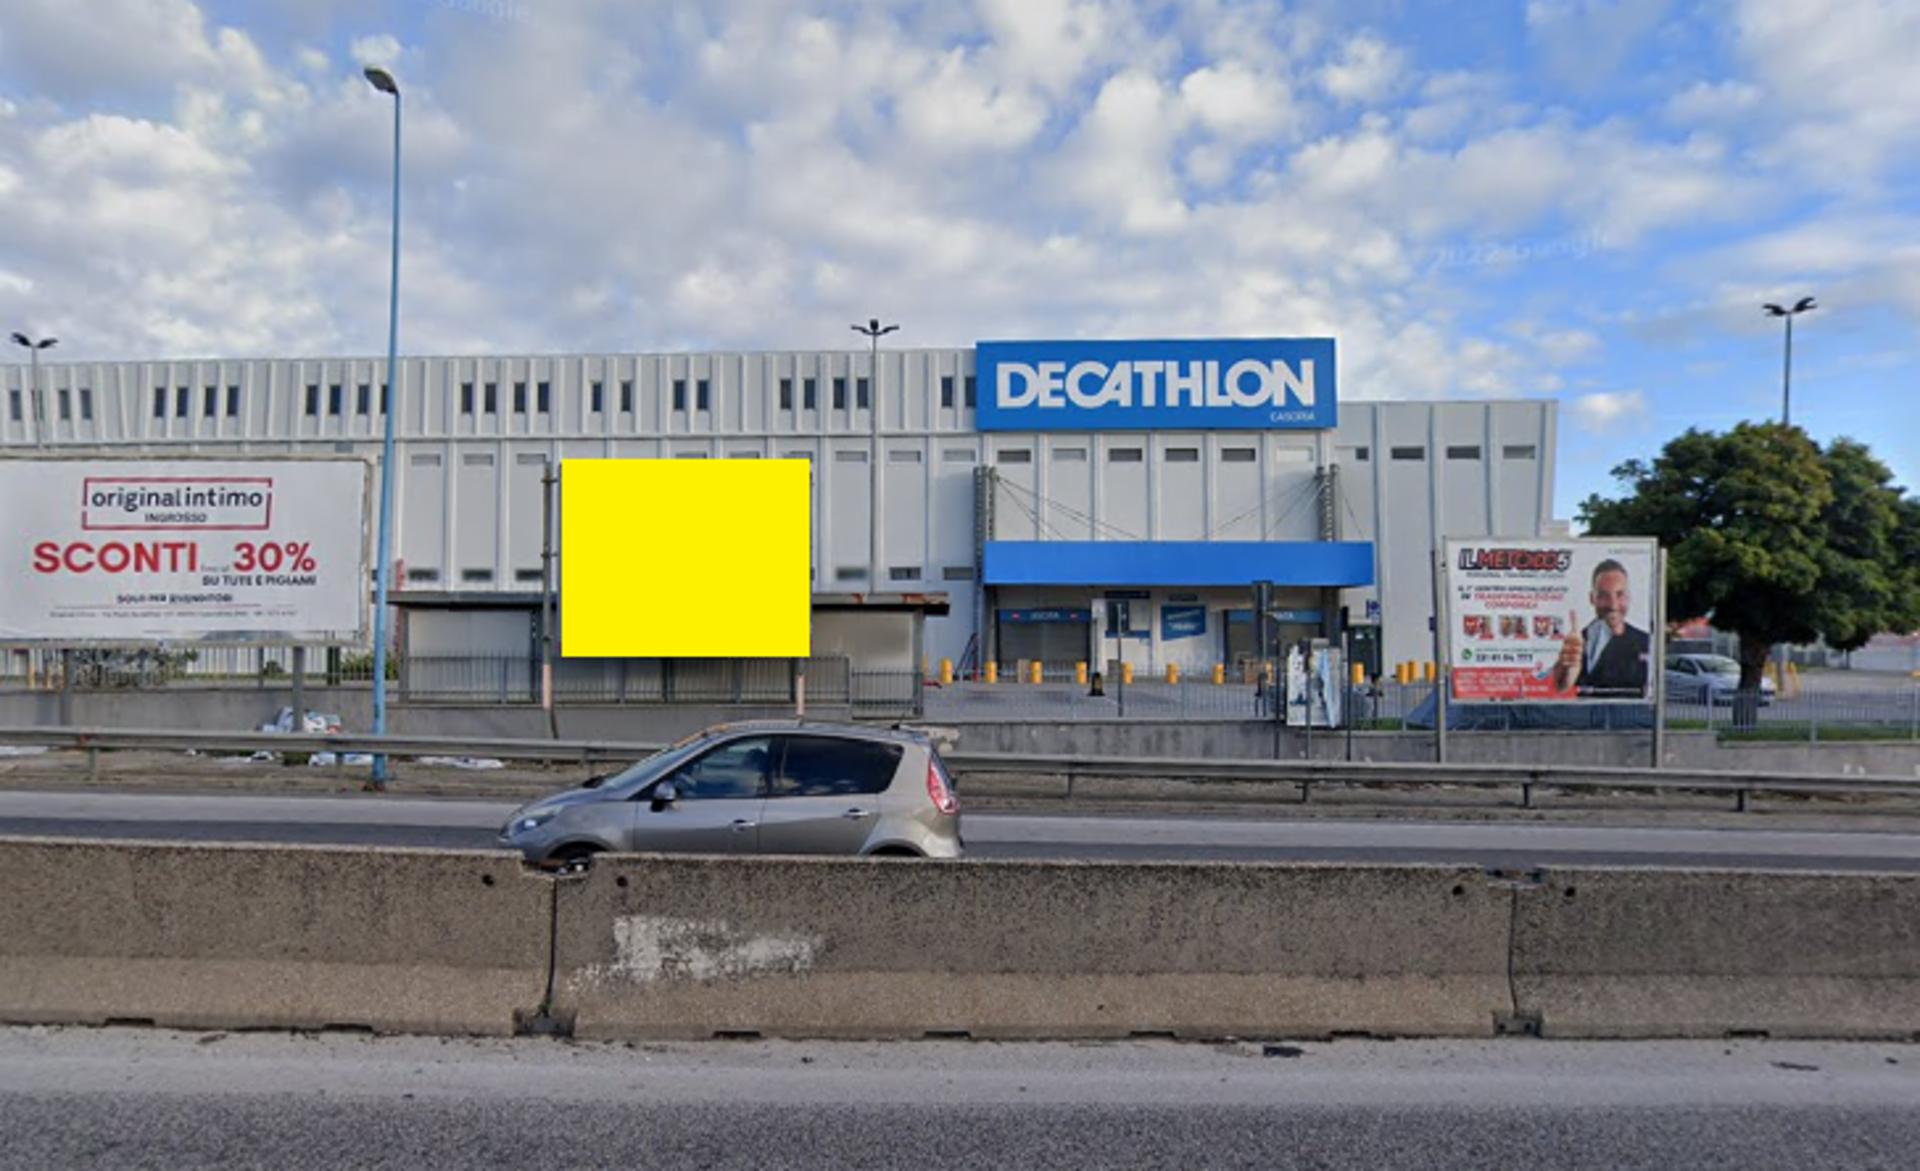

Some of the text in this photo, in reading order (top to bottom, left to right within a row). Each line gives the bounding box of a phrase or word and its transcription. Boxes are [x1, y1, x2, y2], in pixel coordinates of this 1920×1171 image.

[996, 358, 1315, 409] DECATHLON
[144, 513, 208, 524] INGROSSO
[33, 541, 197, 573] SCONTI
[234, 541, 317, 573] 30%
[202, 575, 220, 587] SU
[223, 575, 252, 587] TUTE
[255, 575, 263, 587] E
